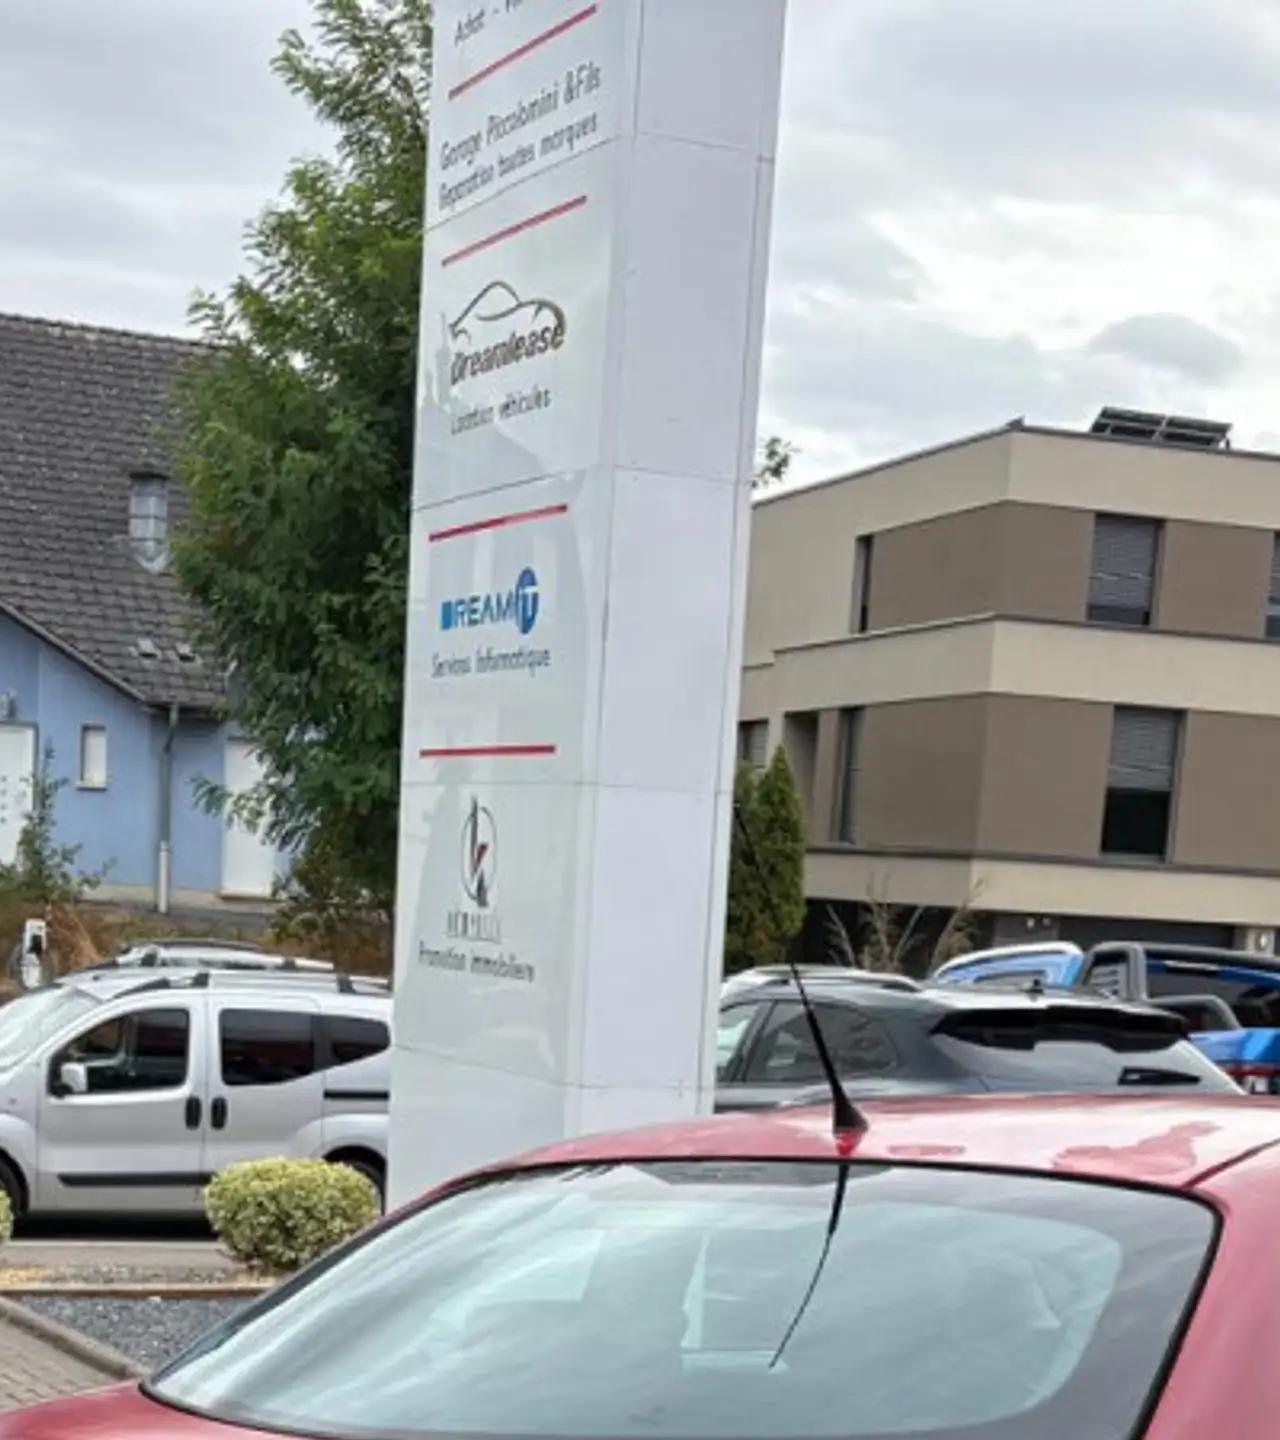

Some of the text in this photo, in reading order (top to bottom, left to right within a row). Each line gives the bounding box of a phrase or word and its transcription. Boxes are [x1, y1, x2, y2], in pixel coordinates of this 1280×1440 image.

[440, 131, 482, 170] Garage
[498, 144, 535, 177] toutes
[538, 112, 598, 157] marques
[451, 326, 565, 386] Dreamlease
